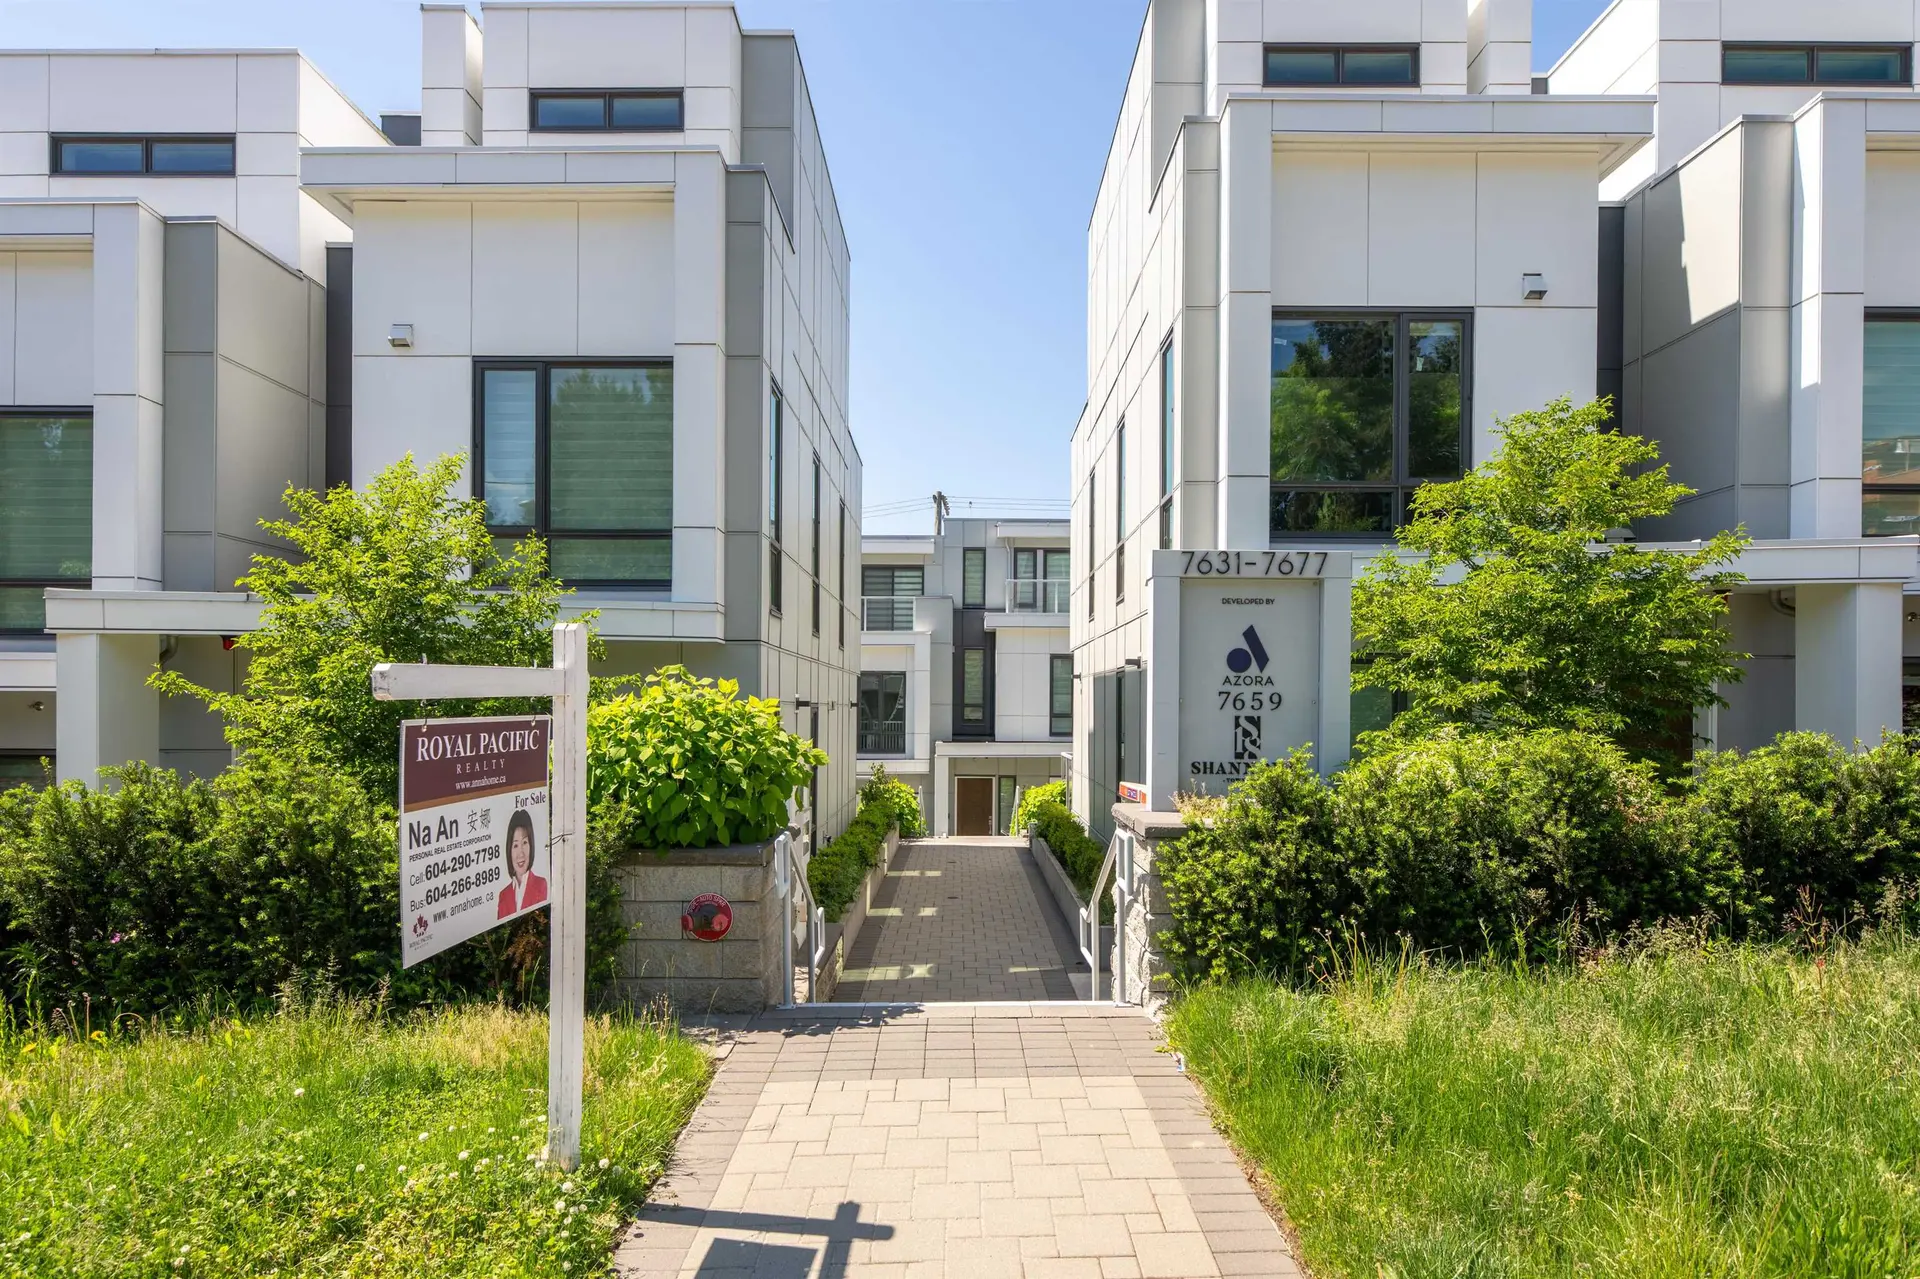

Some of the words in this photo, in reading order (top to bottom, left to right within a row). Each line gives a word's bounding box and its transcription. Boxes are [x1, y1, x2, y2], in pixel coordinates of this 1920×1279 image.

[1181, 551, 1328, 576] 7631-7677
[1222, 597, 1264, 606] DEVELOPED
[1265, 597, 1276, 606] BY
[1222, 675, 1275, 686] AZORA
[1218, 691, 1282, 711] 7659
[416, 733, 476, 762] ROYAL
[479, 729, 540, 755] PACIFIC
[456, 758, 505, 775] REALTY
[455, 774, 507, 790] www.annahome.ca
[515, 795, 529, 809] For
[530, 791, 546, 805] Sale
[409, 820, 432, 850] Na
[436, 815, 459, 843] An
[409, 850, 433, 862] PERSONAL
[434, 846, 446, 856] REAL
[447, 841, 462, 851] ESTATE
[463, 834, 492, 847] CORPORATION
